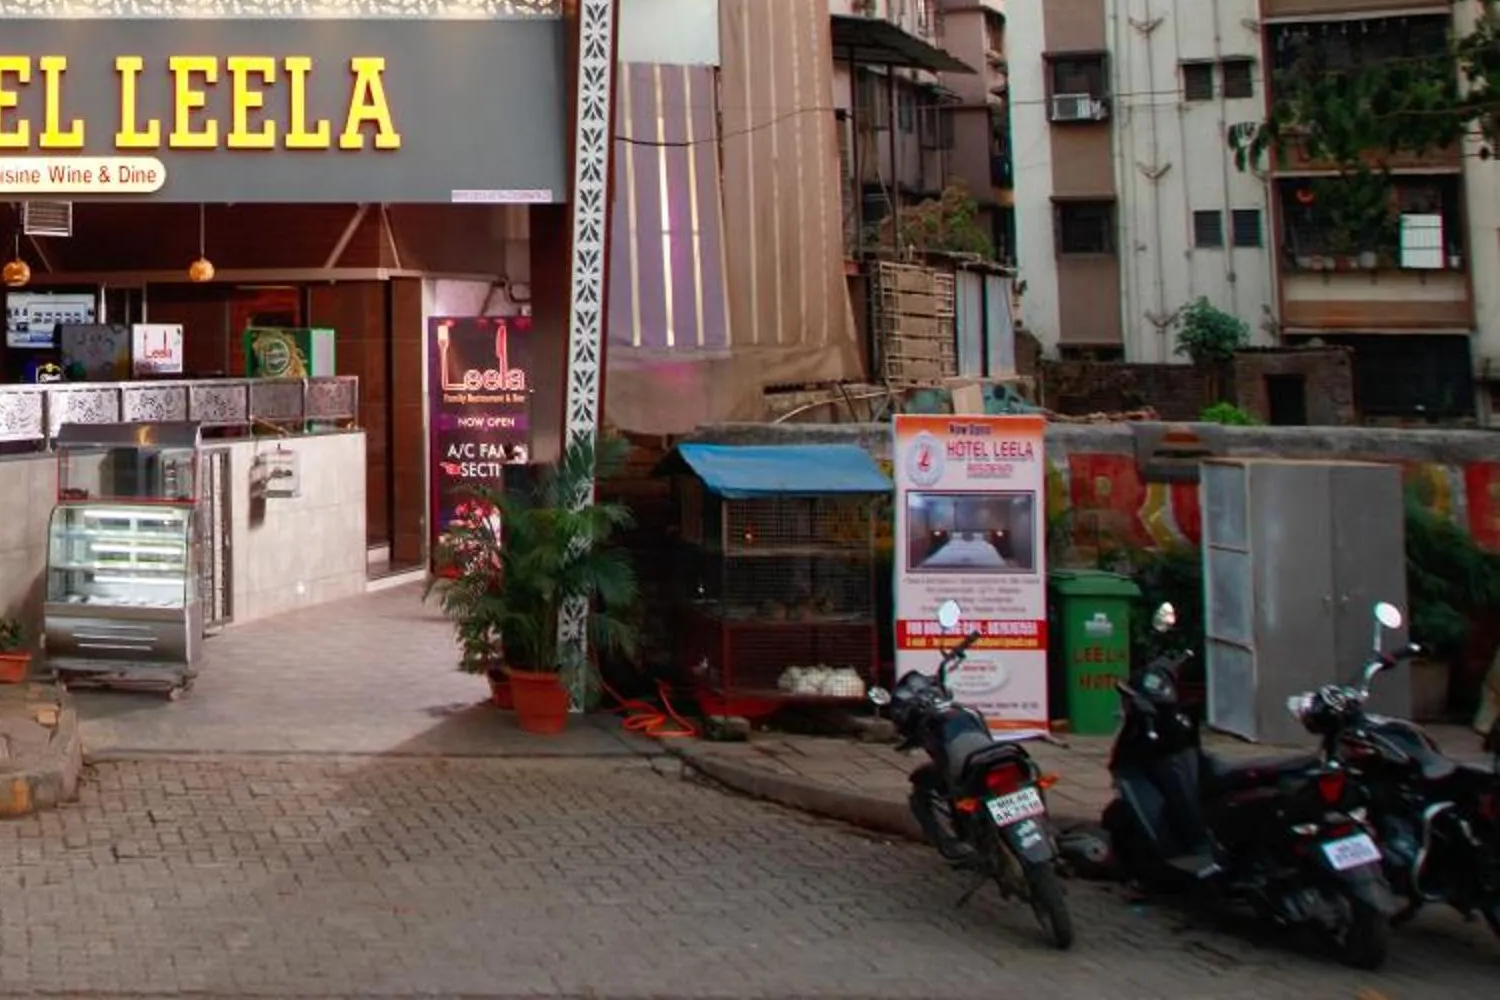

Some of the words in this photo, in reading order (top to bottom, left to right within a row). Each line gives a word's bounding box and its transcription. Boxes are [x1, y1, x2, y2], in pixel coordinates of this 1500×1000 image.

[115, 55, 401, 149] LEELA
[47, 165, 93, 184] Wine
[97, 165, 111, 184] &
[118, 165, 157, 184] Dine
[438, 325, 525, 390] Leela
[457, 417, 485, 428] NOW
[487, 417, 515, 428] OPEN
[447, 443, 476, 459] A/C
[947, 440, 989, 457] HOTEL
[993, 440, 1034, 457] LEELA
